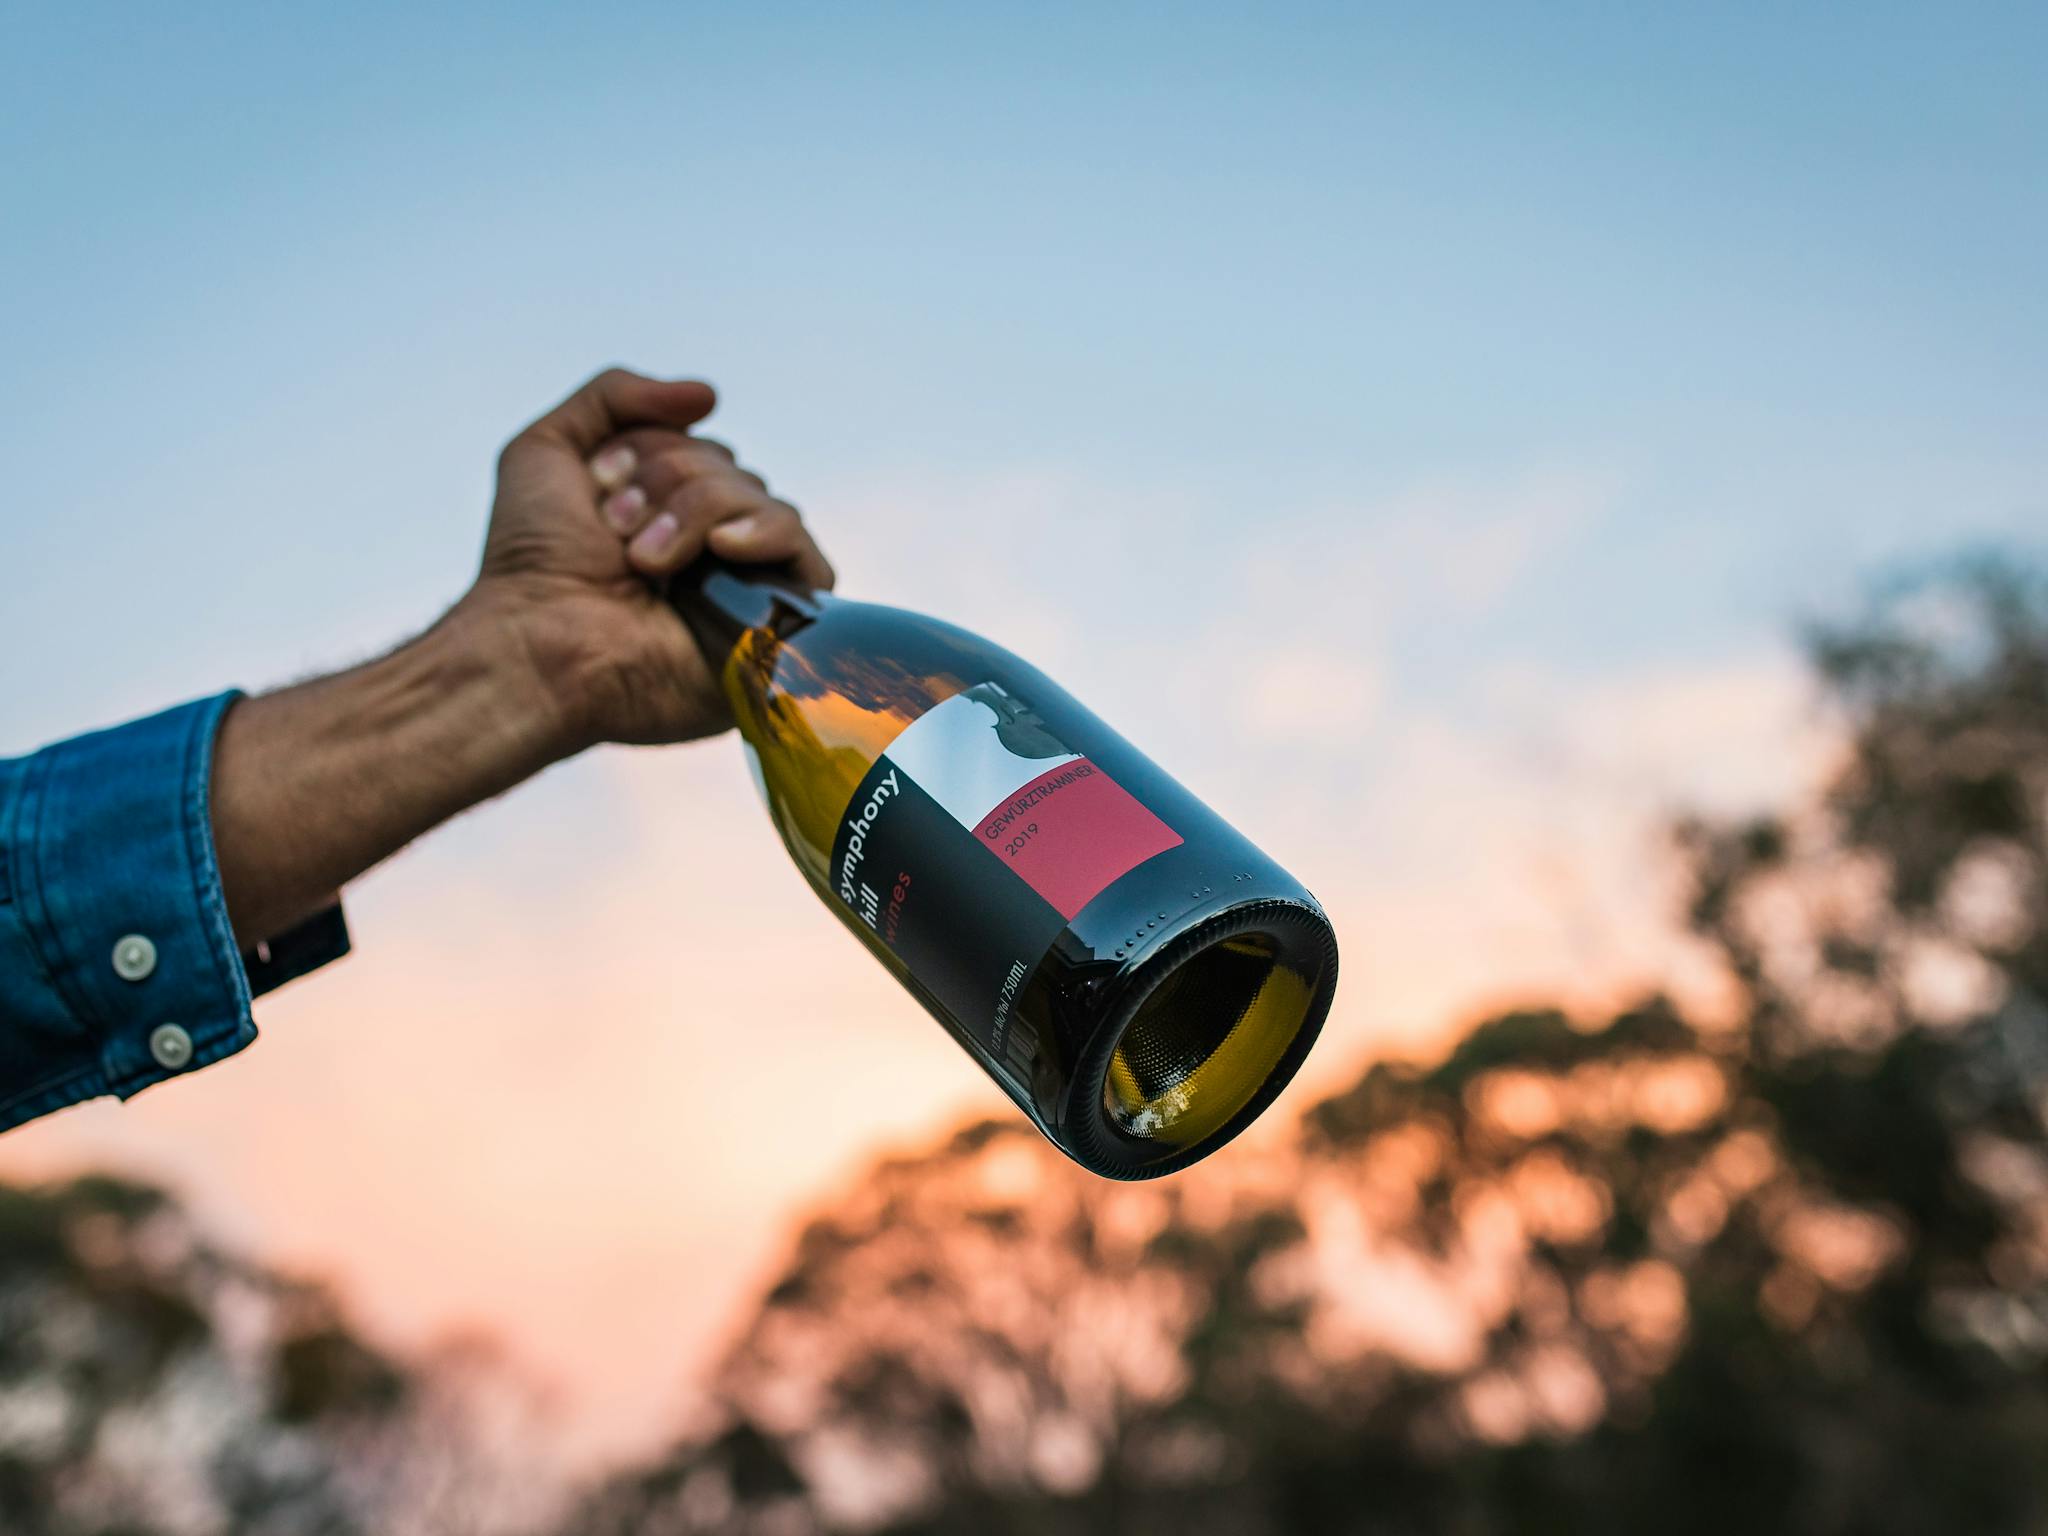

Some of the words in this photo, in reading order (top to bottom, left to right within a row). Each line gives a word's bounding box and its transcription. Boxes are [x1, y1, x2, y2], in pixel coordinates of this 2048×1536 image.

[841, 769, 900, 904] symphony
[985, 765, 1096, 840] GEWÜRZTRAMINER
[1005, 823, 1038, 857] 2019
[860, 882, 879, 929] hill
[885, 872, 912, 944] wines
